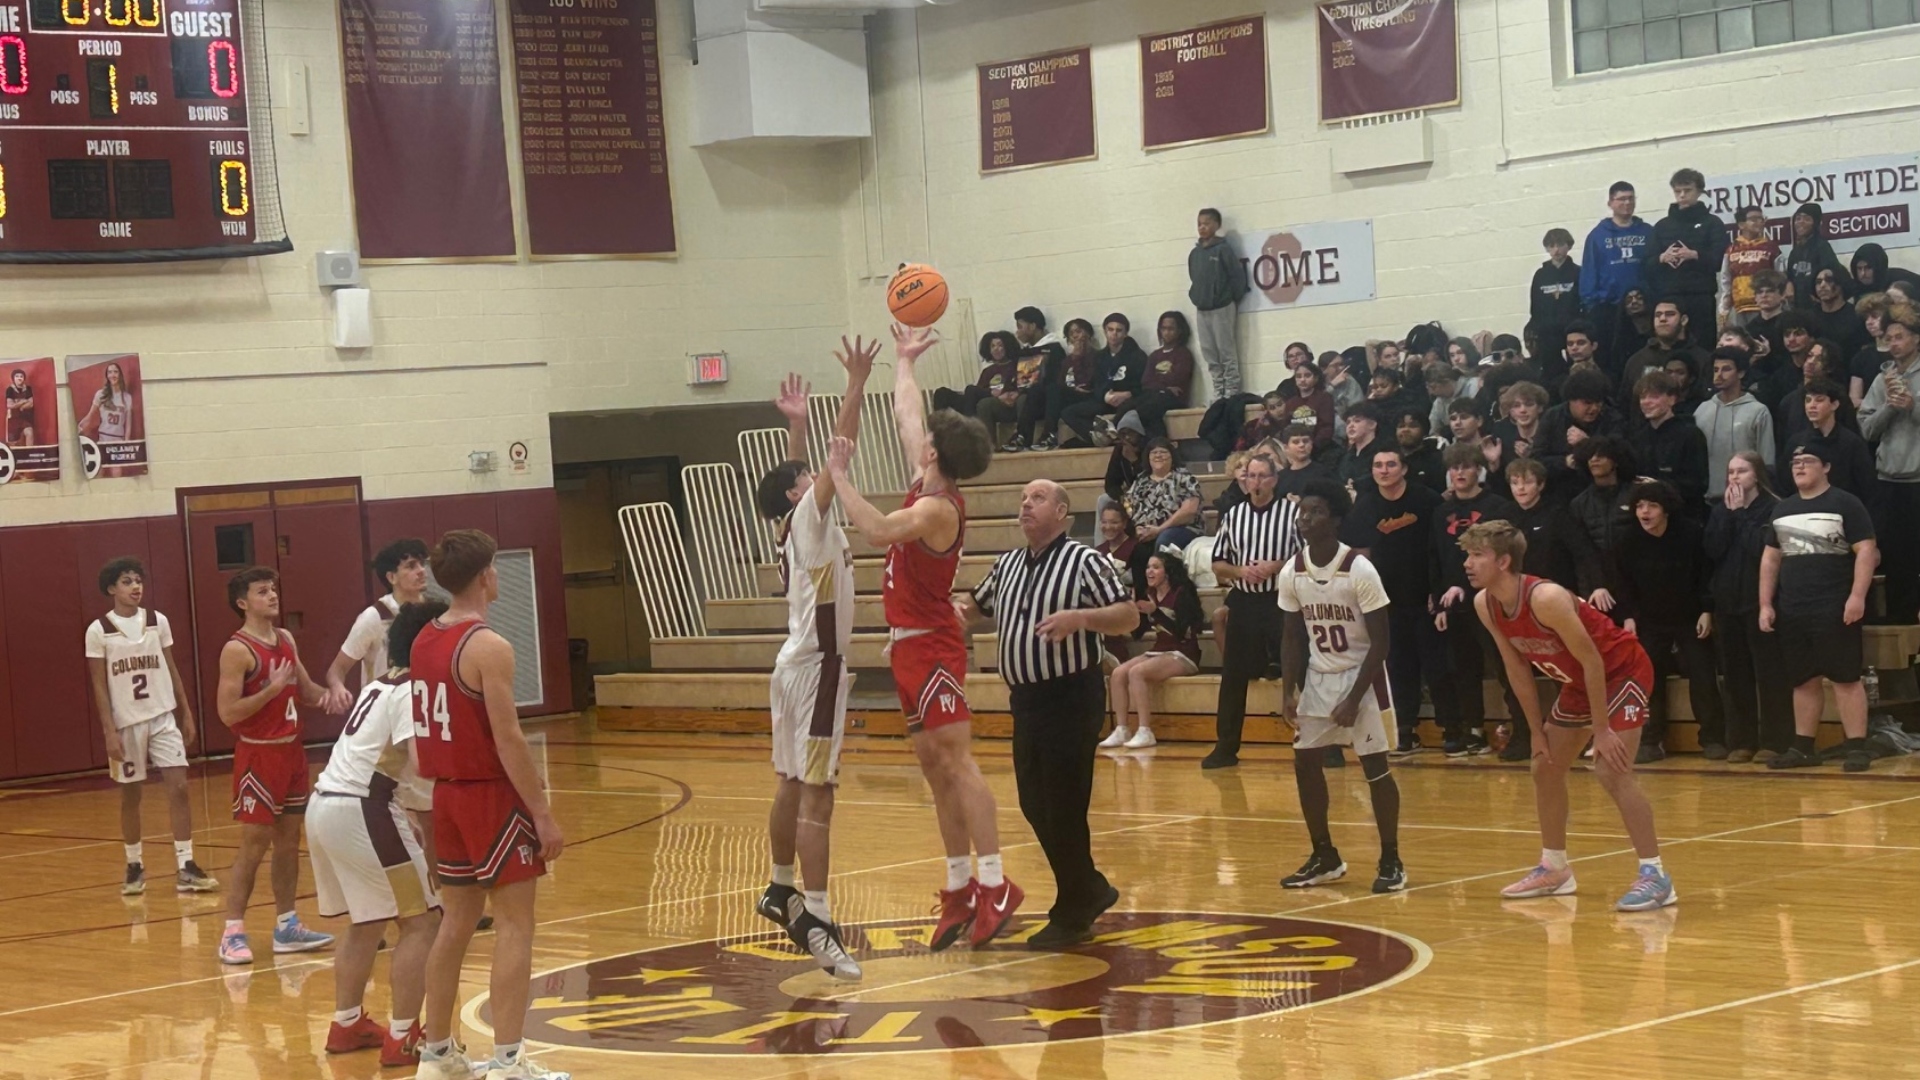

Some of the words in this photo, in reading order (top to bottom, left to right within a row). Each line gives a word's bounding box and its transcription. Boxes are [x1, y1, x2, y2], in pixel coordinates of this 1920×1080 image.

[170, 11, 232, 37] GUEST
[1351, 9, 1416, 32] WRESTLING
[78, 40, 121, 56] PERIOD
[1150, 33, 1194, 53] DISTRICT
[1197, 23, 1253, 44] CHAMPIONS
[0, 35, 28, 94] 0
[1177, 44, 1227, 63] FOOTBALL
[208, 41, 238, 97] 0
[988, 63, 1027, 80] SECTION
[1028, 54, 1079, 74] CHAMPIONS
[109, 64, 119, 114] 1
[1011, 73, 1056, 90] FOOTBALL
[51, 90, 80, 104] POSS
[131, 91, 158, 105] POSS
[188, 105, 229, 121] BONUS
[86, 140, 130, 155] PLAYER
[209, 140, 245, 155] FOULS
[220, 160, 249, 215] 0
[1845, 165, 1919, 198] TIDE
[99, 222, 132, 237] GAME
[221, 221, 246, 236] WON
[1829, 212, 1902, 234] SECTION
[896, 279, 923, 300] NCAA
[1312, 624, 1349, 653] 20
[112, 653, 160, 677] COLUMBIA
[132, 674, 150, 700] 2
[285, 696, 298, 728] 4
[344, 688, 382, 736] 0
[413, 679, 452, 741] 34
[122, 762, 135, 778] C
